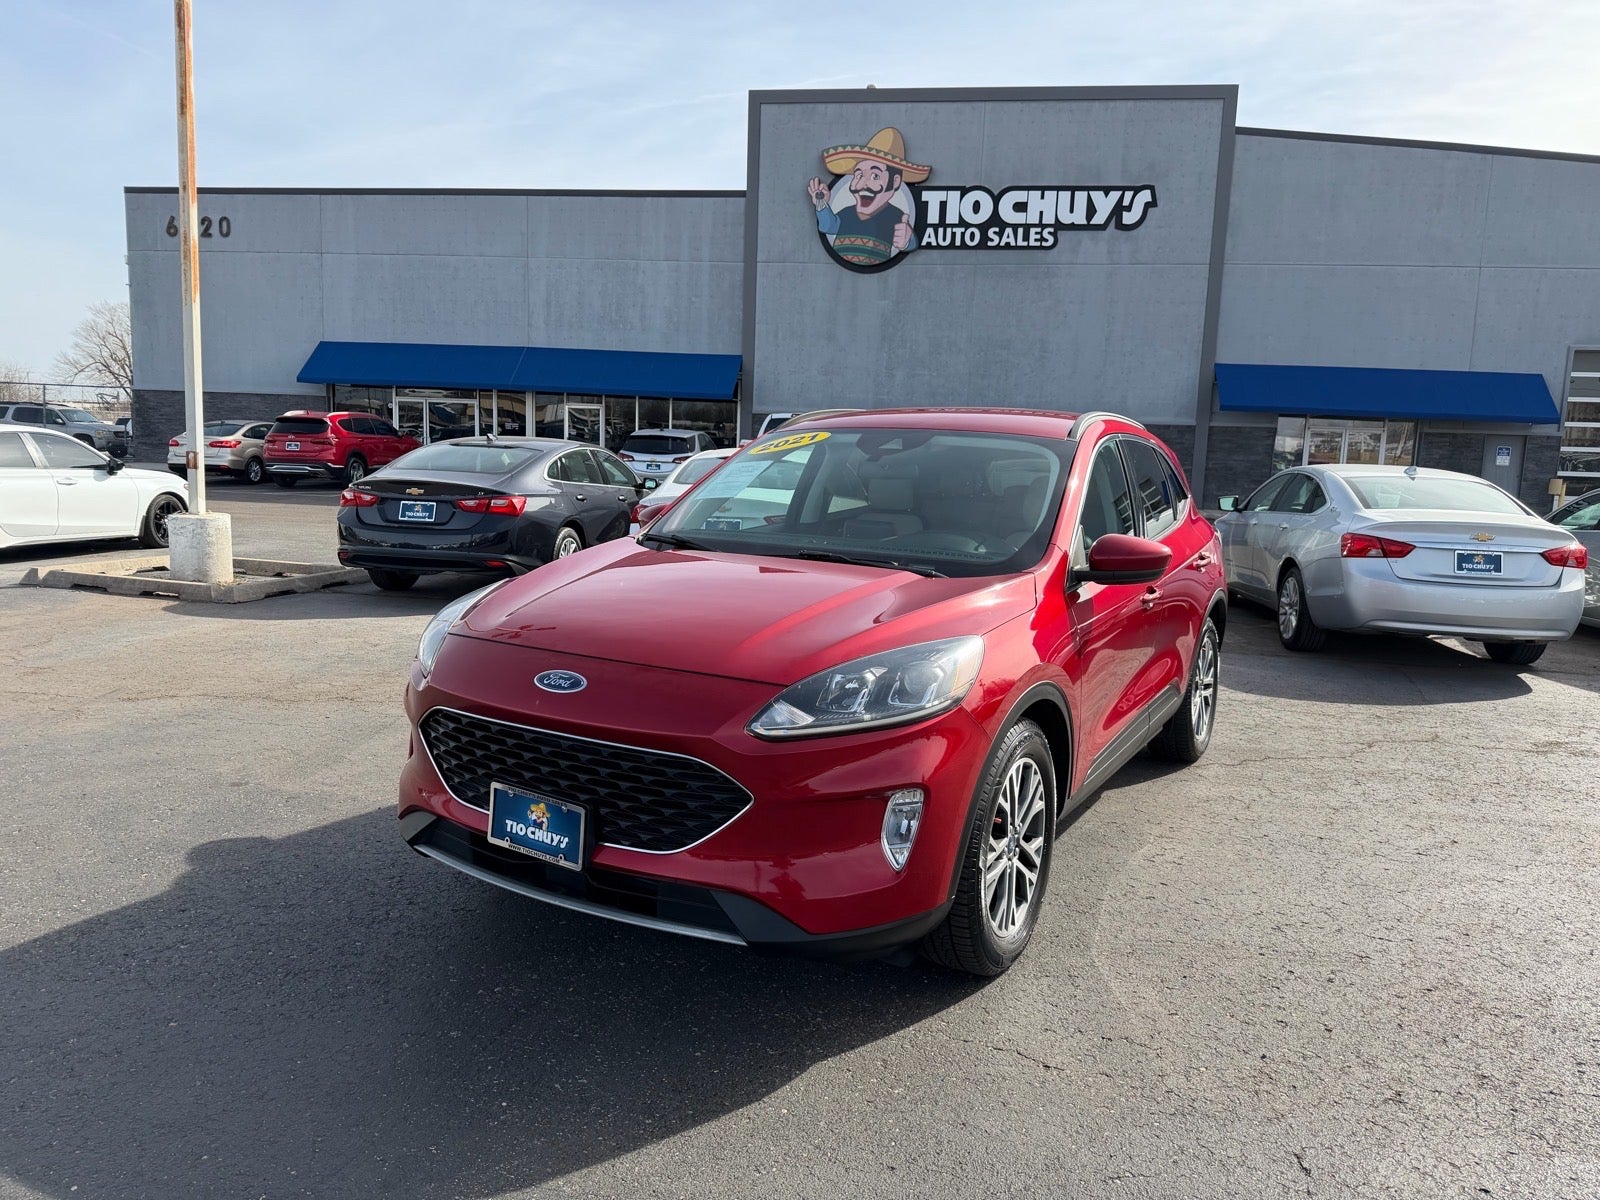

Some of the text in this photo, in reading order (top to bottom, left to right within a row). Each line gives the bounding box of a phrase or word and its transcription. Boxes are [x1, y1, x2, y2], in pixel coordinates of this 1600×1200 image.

[921, 189, 1152, 225] TIO CHUY'S
[166, 215, 231, 238] 620
[921, 227, 1055, 247] AUTO SALES
[757, 433, 819, 452] 2021
[543, 673, 575, 687] Ford
[505, 819, 569, 849] TIO CHUY'S
